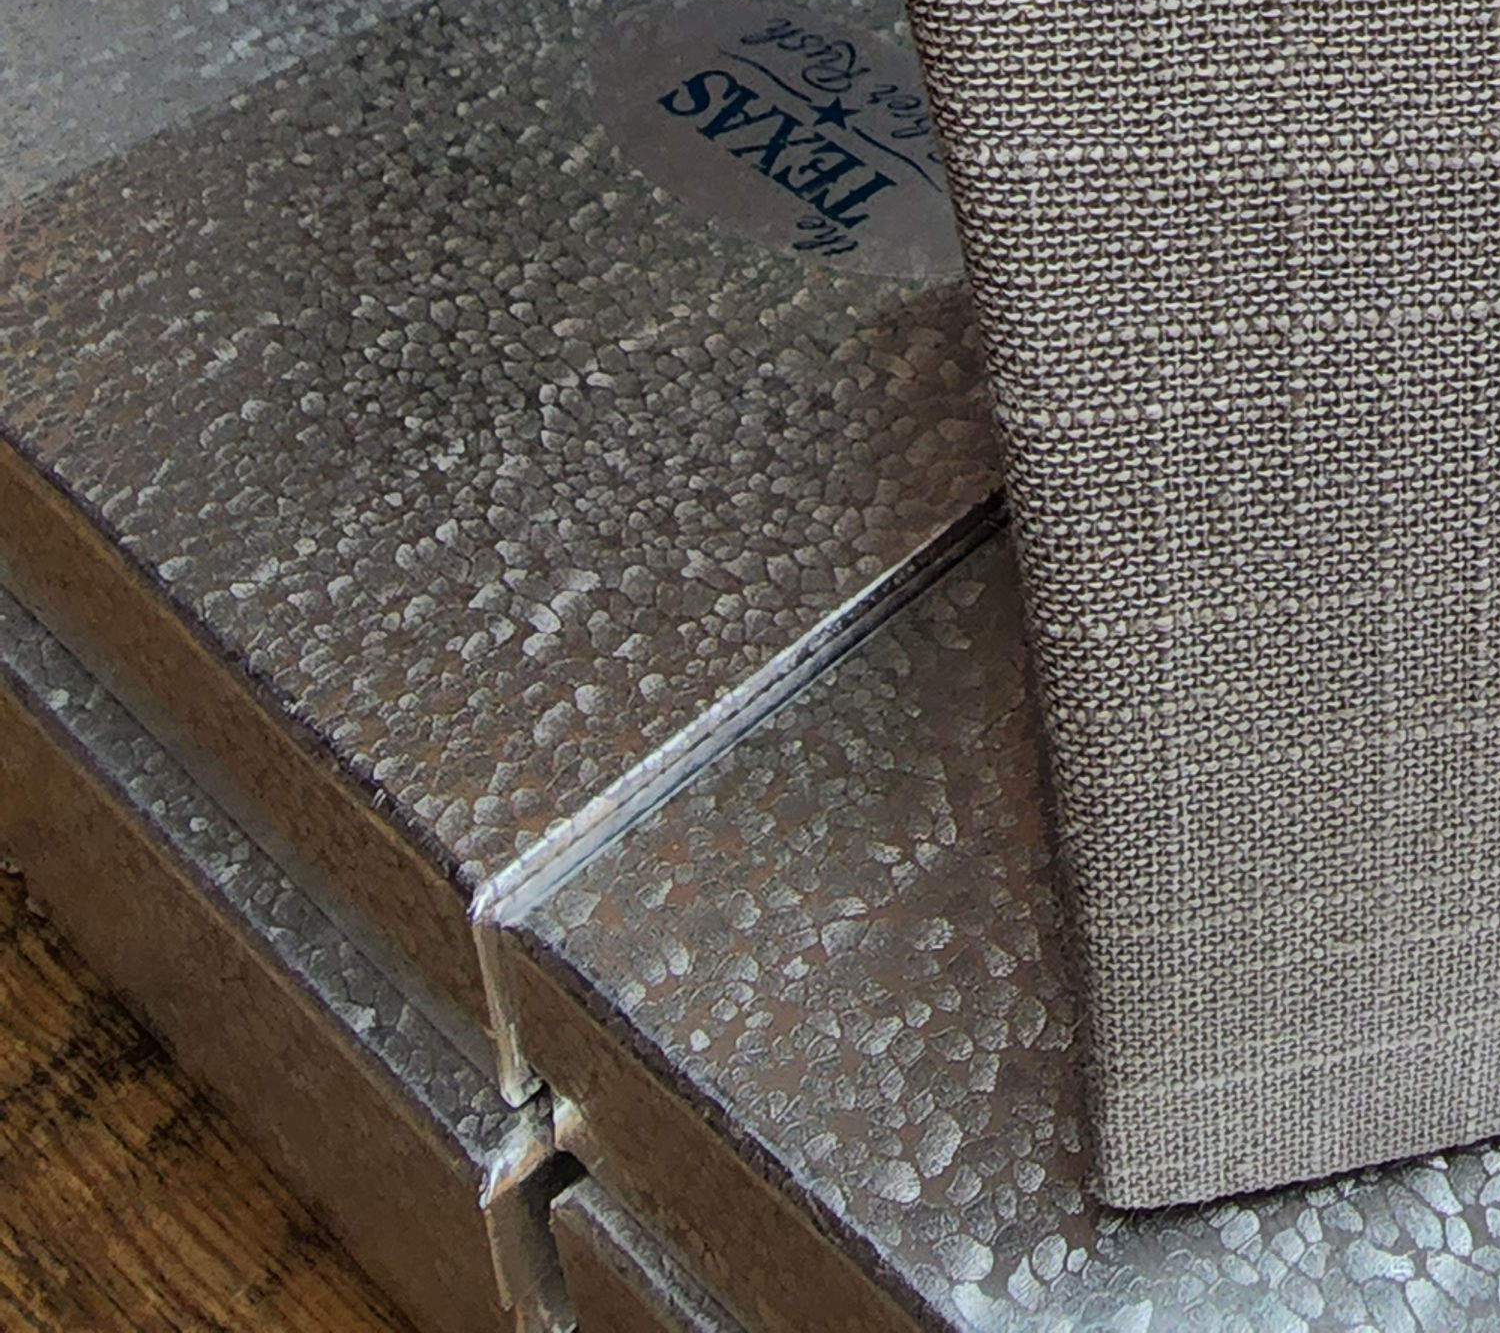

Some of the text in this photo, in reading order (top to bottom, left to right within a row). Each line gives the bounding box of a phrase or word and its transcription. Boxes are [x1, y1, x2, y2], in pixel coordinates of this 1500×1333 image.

[740, 18, 872, 95] Rush
[656, 69, 896, 230] TEXAS
[792, 216, 860, 258] the
